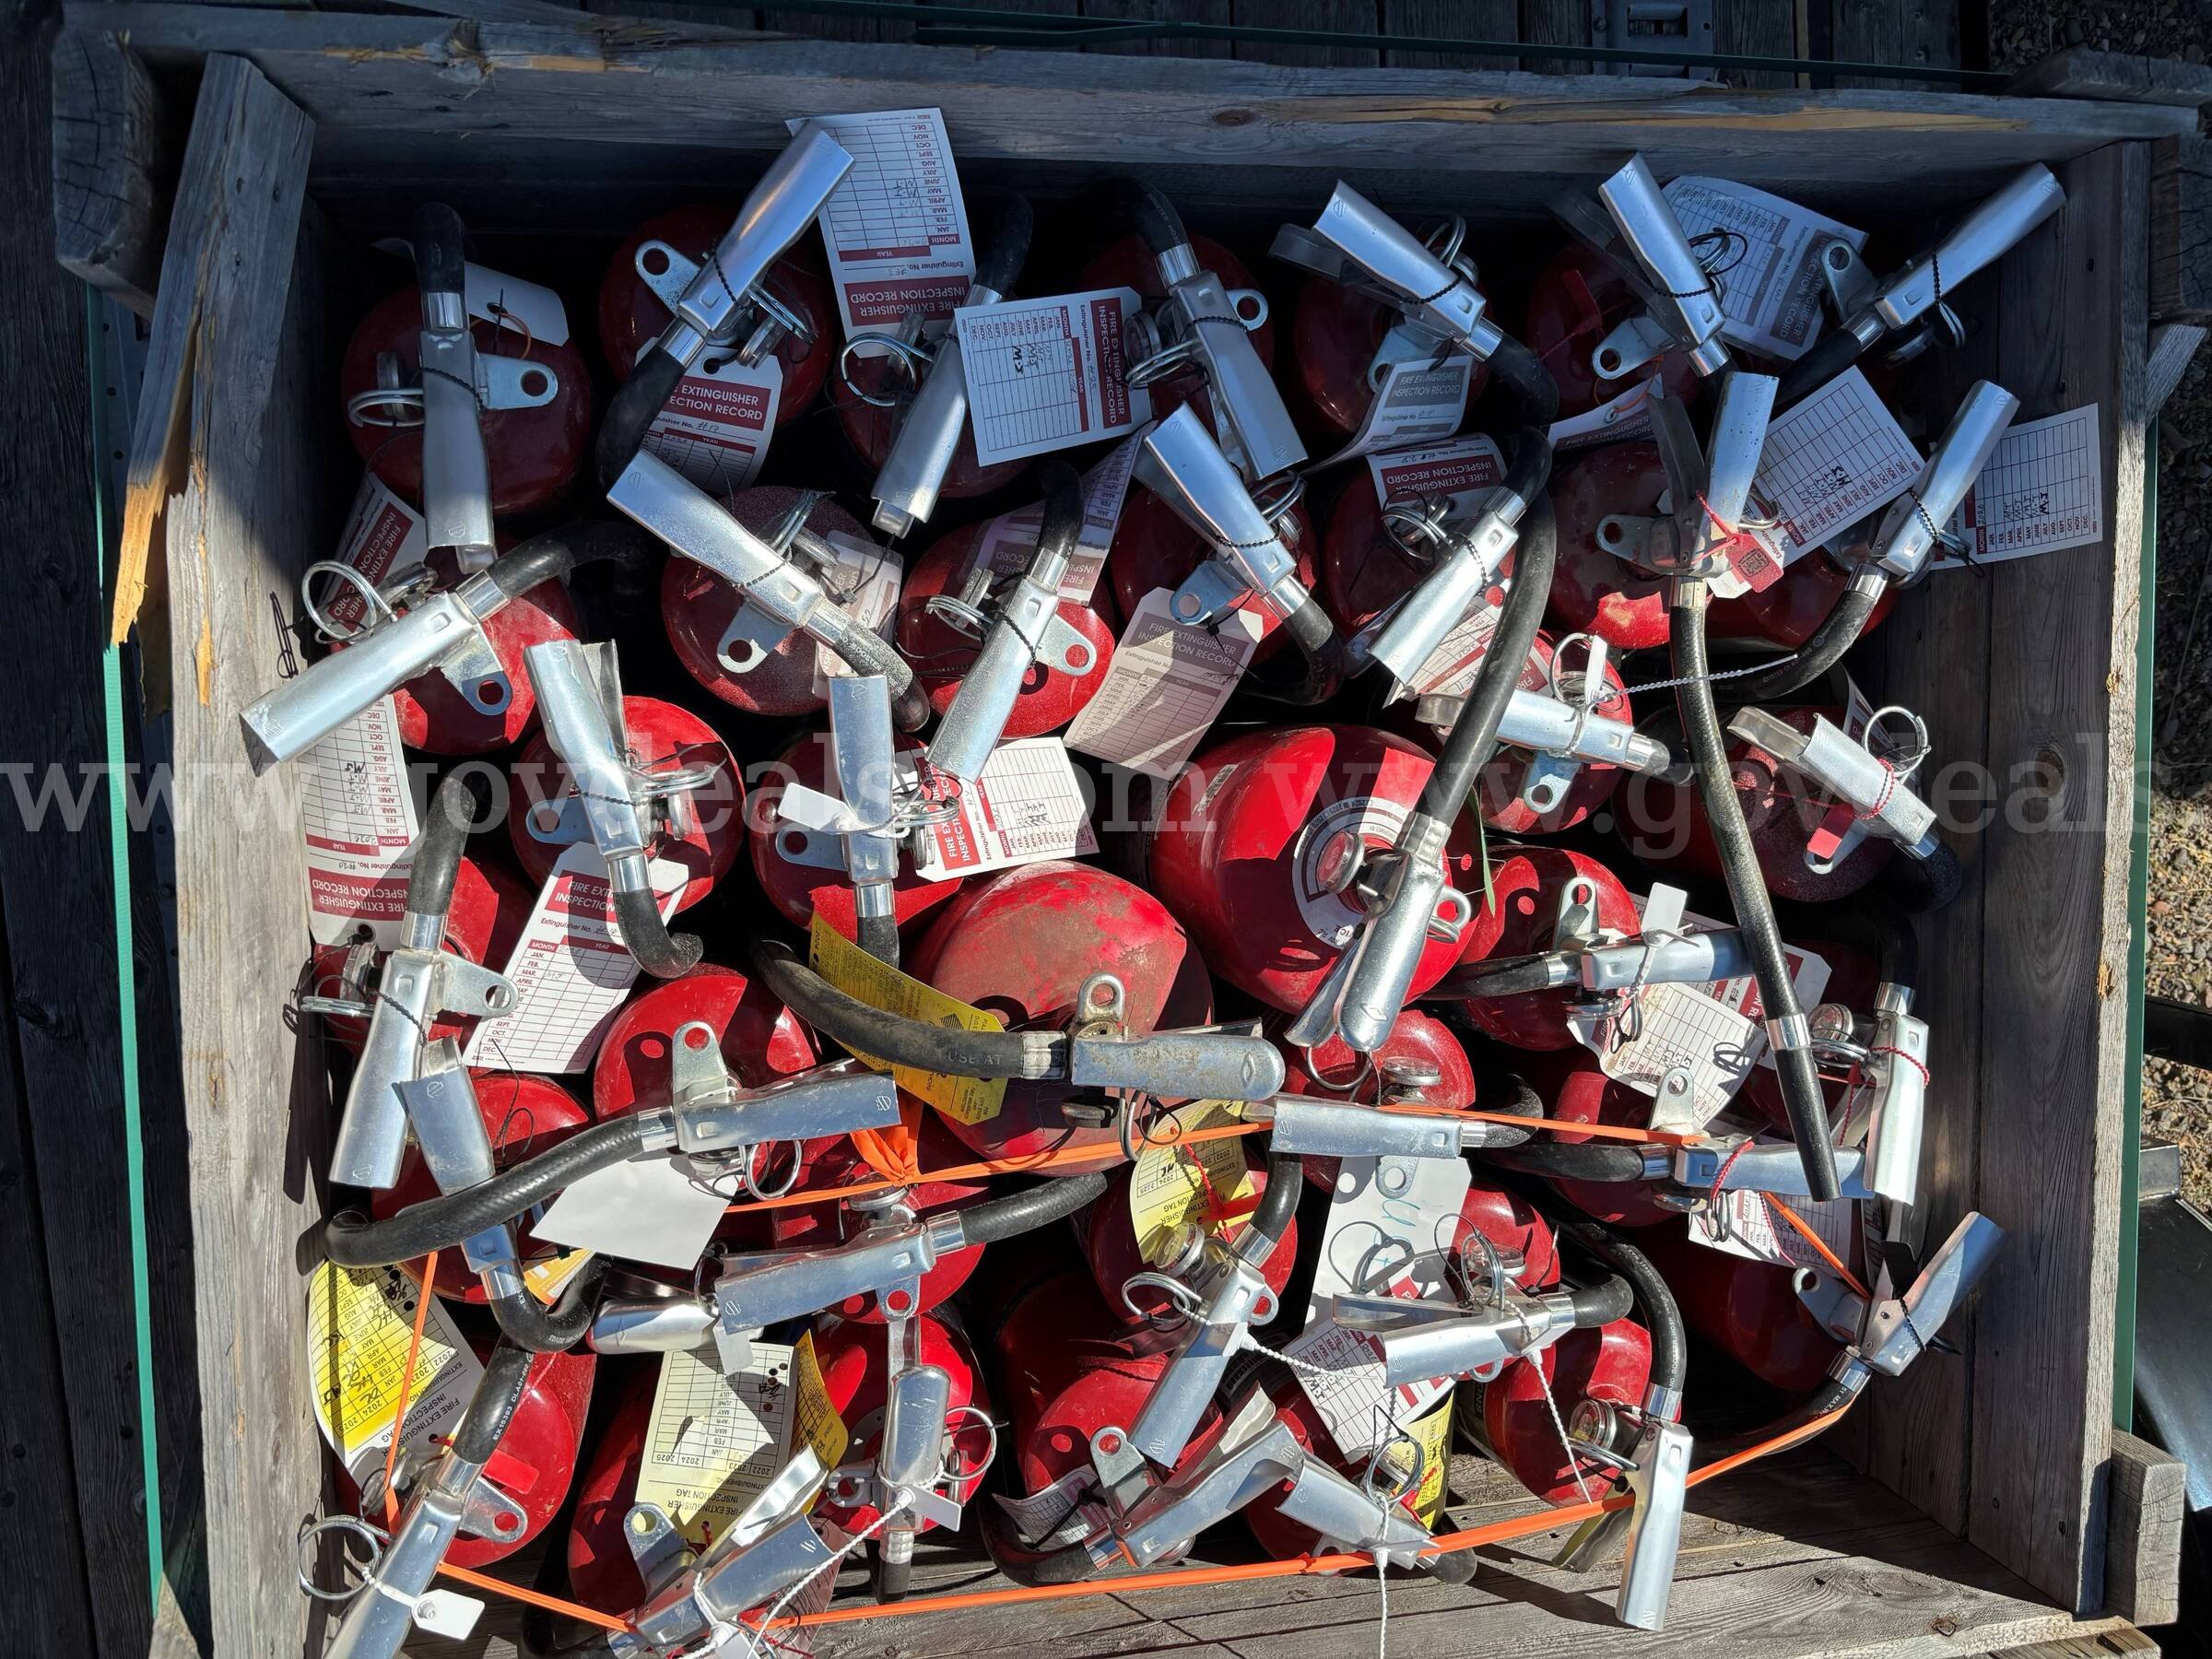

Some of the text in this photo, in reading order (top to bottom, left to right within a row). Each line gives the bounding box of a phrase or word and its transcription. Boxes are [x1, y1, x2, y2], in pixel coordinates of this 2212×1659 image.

[850, 287, 965, 301] INSPECTION RECORD
[1108, 312, 1117, 334] FIRE
[1778, 296, 1802, 338] RECORD
[681, 384, 759, 406] EXTINGUISHER
[1429, 383, 1460, 394] RECORD
[1105, 376, 1116, 423] RECORD
[715, 403, 762, 420] RECORD
[1386, 461, 1490, 483] INSPECTION RECORD
[1467, 472, 1488, 481] FIRE
[1840, 493, 1853, 508] JUNE
[1849, 488, 1861, 501] JULY
[1822, 504, 1836, 519] APRIL
[1831, 500, 1843, 512] MAY
[384, 525, 401, 547] FIRE
[1785, 523, 1803, 543] MONTH
[1137, 630, 1236, 668] INSPECTION RECORD
[1124, 650, 1162, 667] Extinguisher
[945, 836, 957, 857] FIRE
[1000, 832, 1009, 853] MONTH
[369, 860, 413, 869] Extinguisher
[311, 877, 348, 891] RECORD
[567, 880, 590, 891] FIRE
[318, 895, 384, 911] EXTINGUISHER
[540, 918, 579, 929] Extinguisher
[531, 942, 555, 950] MONTH
[1634, 1061, 1645, 1076] MAR.
[1159, 1174, 1173, 1185] 2024
[1159, 1198, 1209, 1223] EXTINGUISHER
[1162, 1200, 1177, 1211] TAG
[338, 1297, 353, 1311] SEPT
[344, 1307, 357, 1320] AUG
[348, 1316, 363, 1330] JULY
[352, 1326, 369, 1342] JUNE
[360, 1337, 374, 1350] MAY
[366, 1347, 381, 1359] APR
[433, 1349, 452, 1367] 2022
[1311, 1349, 1321, 1362] MAY
[1317, 1343, 1329, 1359] APRIL
[371, 1355, 386, 1369] MAR
[378, 1364, 392, 1378] FEB
[383, 1374, 397, 1387] JAN
[416, 1360, 462, 1397] EXTINGUISHER
[361, 1399, 382, 1417] 2024
[439, 1396, 460, 1417] FIRE
[380, 1430, 394, 1443] AG
[655, 1453, 675, 1462] 2025
[680, 1455, 699, 1465] 2024
[728, 1462, 747, 1472] 2023
[751, 1465, 770, 1475] 2022
[692, 1490, 738, 1503] INSPECTION
